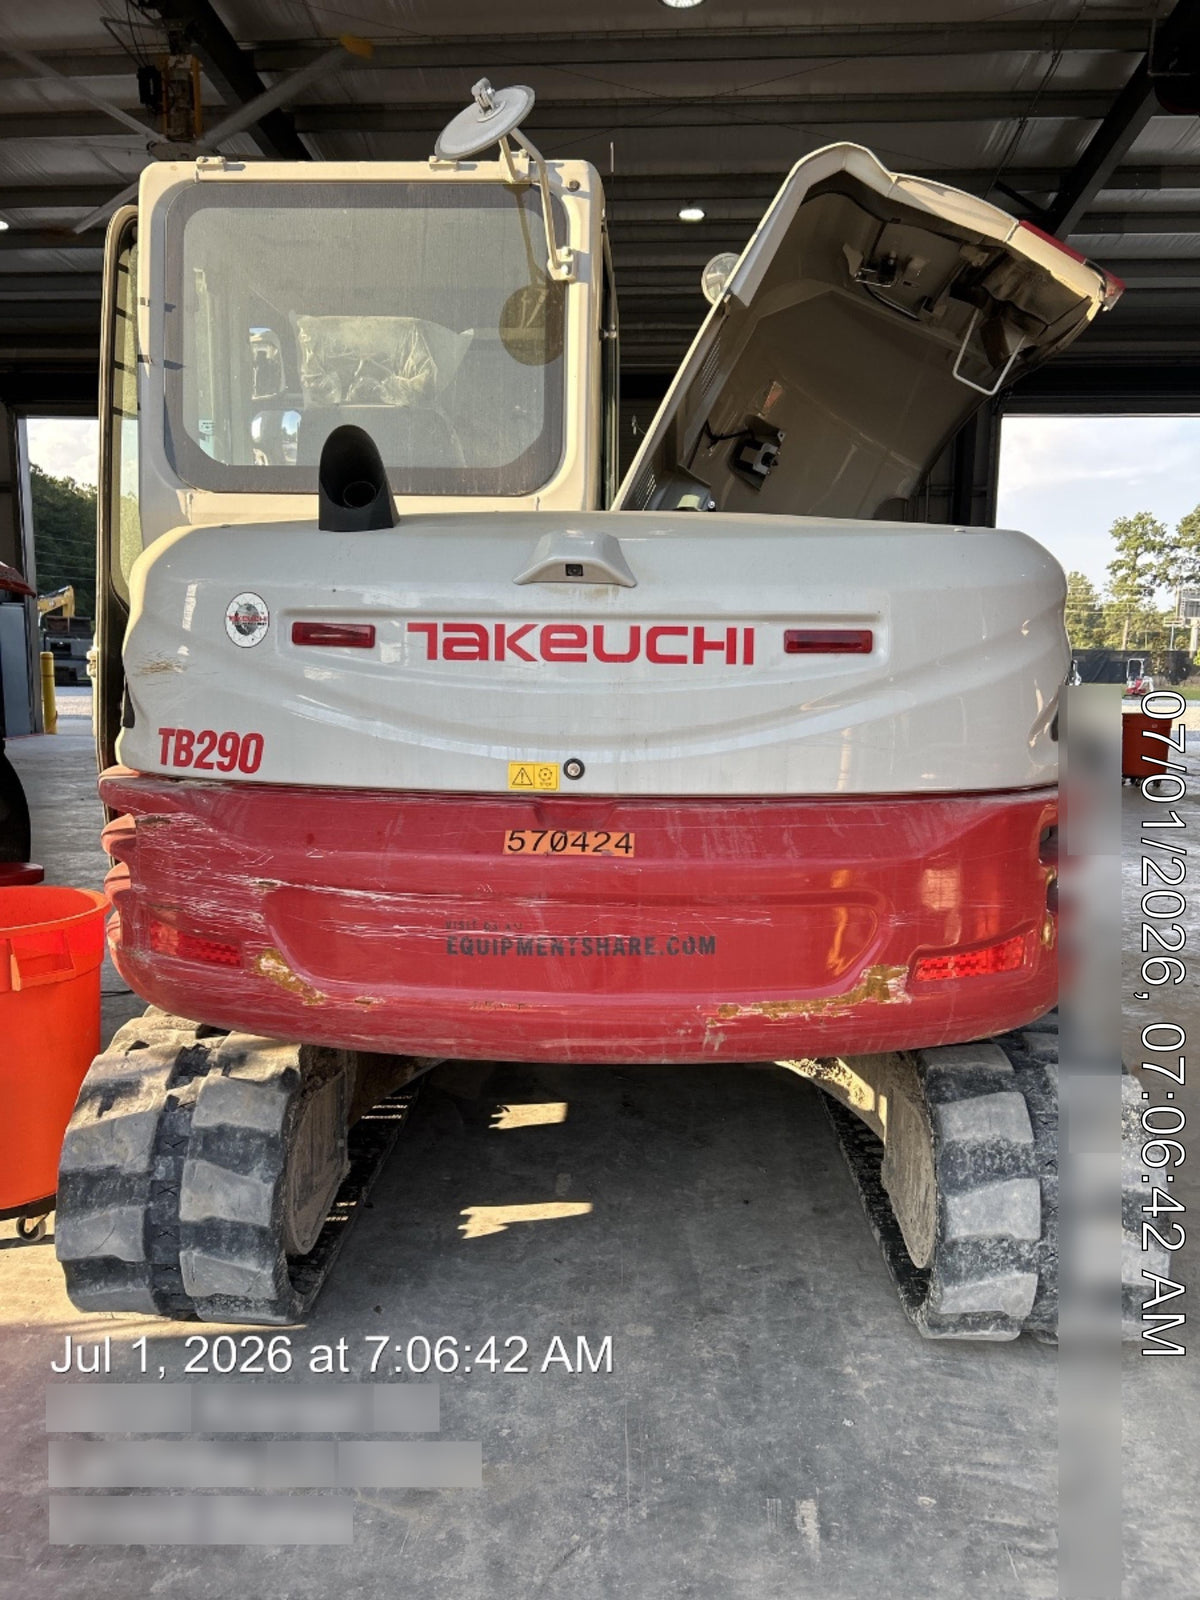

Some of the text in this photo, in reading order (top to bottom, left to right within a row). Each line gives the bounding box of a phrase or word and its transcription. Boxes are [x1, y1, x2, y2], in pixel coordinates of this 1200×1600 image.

[158, 727, 265, 774] TB290
[506, 830, 633, 854] 570424
[446, 935, 717, 957] EQUIPMENTSHARE.COM
